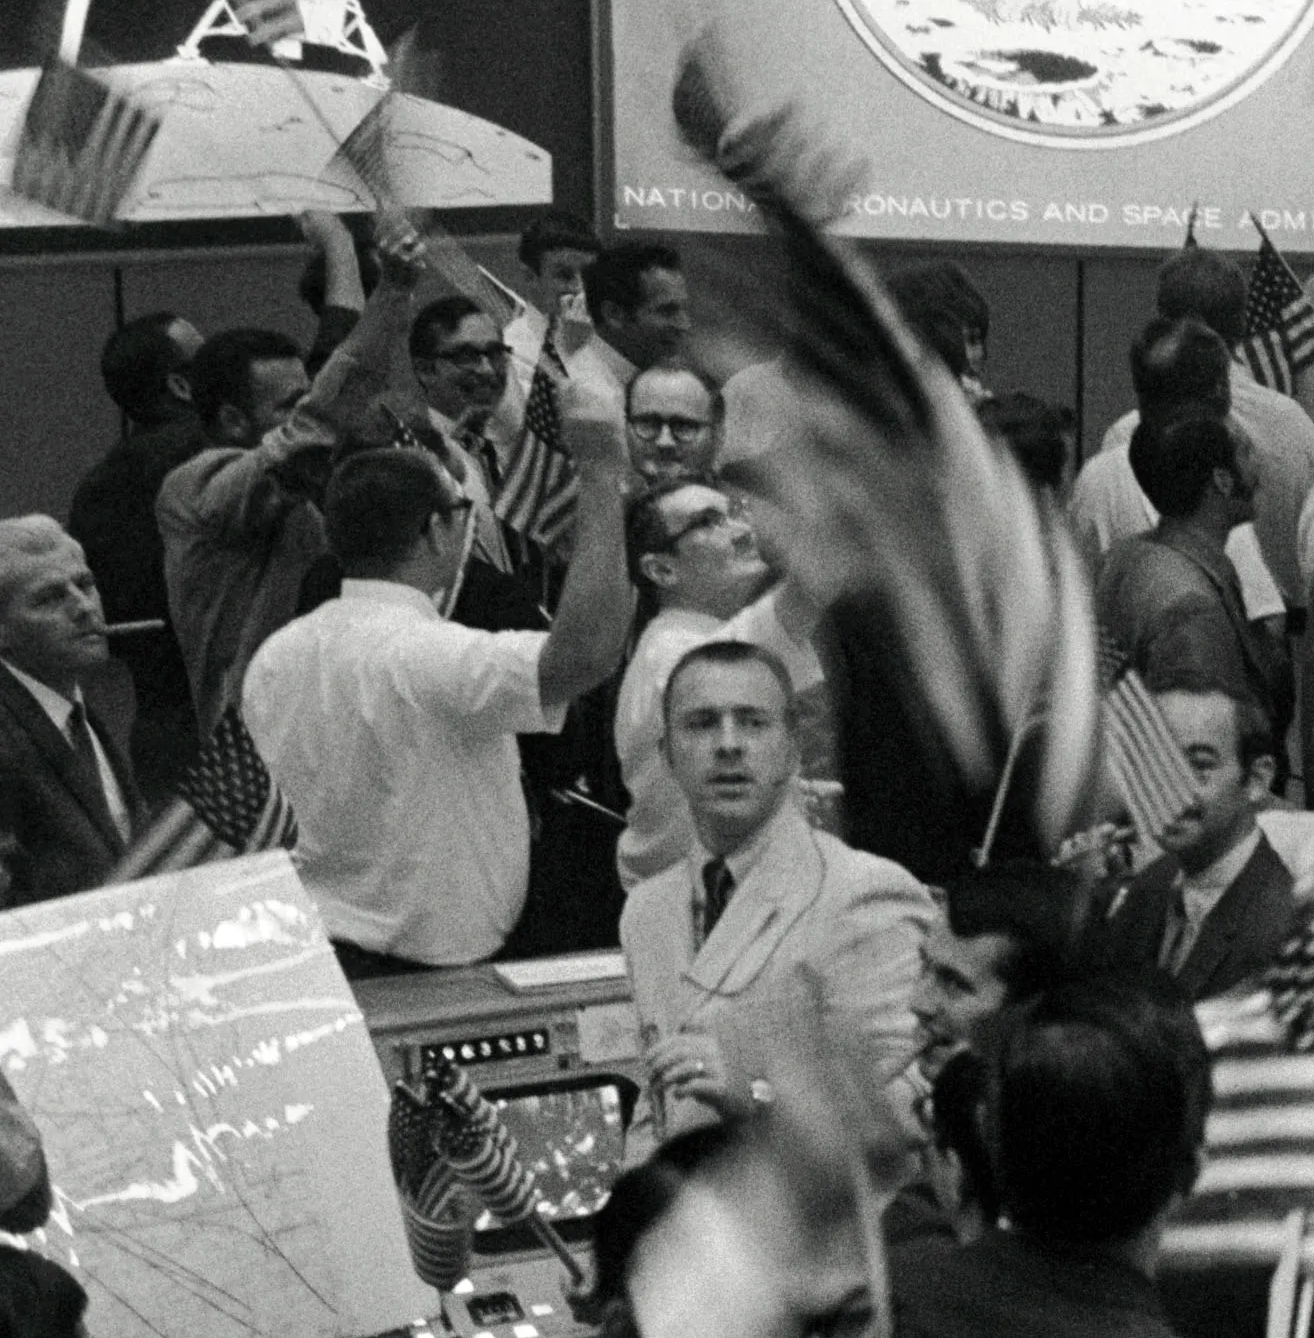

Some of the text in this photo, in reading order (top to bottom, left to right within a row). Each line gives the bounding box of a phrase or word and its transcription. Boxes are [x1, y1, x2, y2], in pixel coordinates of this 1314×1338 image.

[623, 185, 758, 213] NATION
[843, 193, 1030, 222] RONAUTICS
[1042, 202, 1110, 225] AND
[1122, 204, 1223, 230] SPACE
